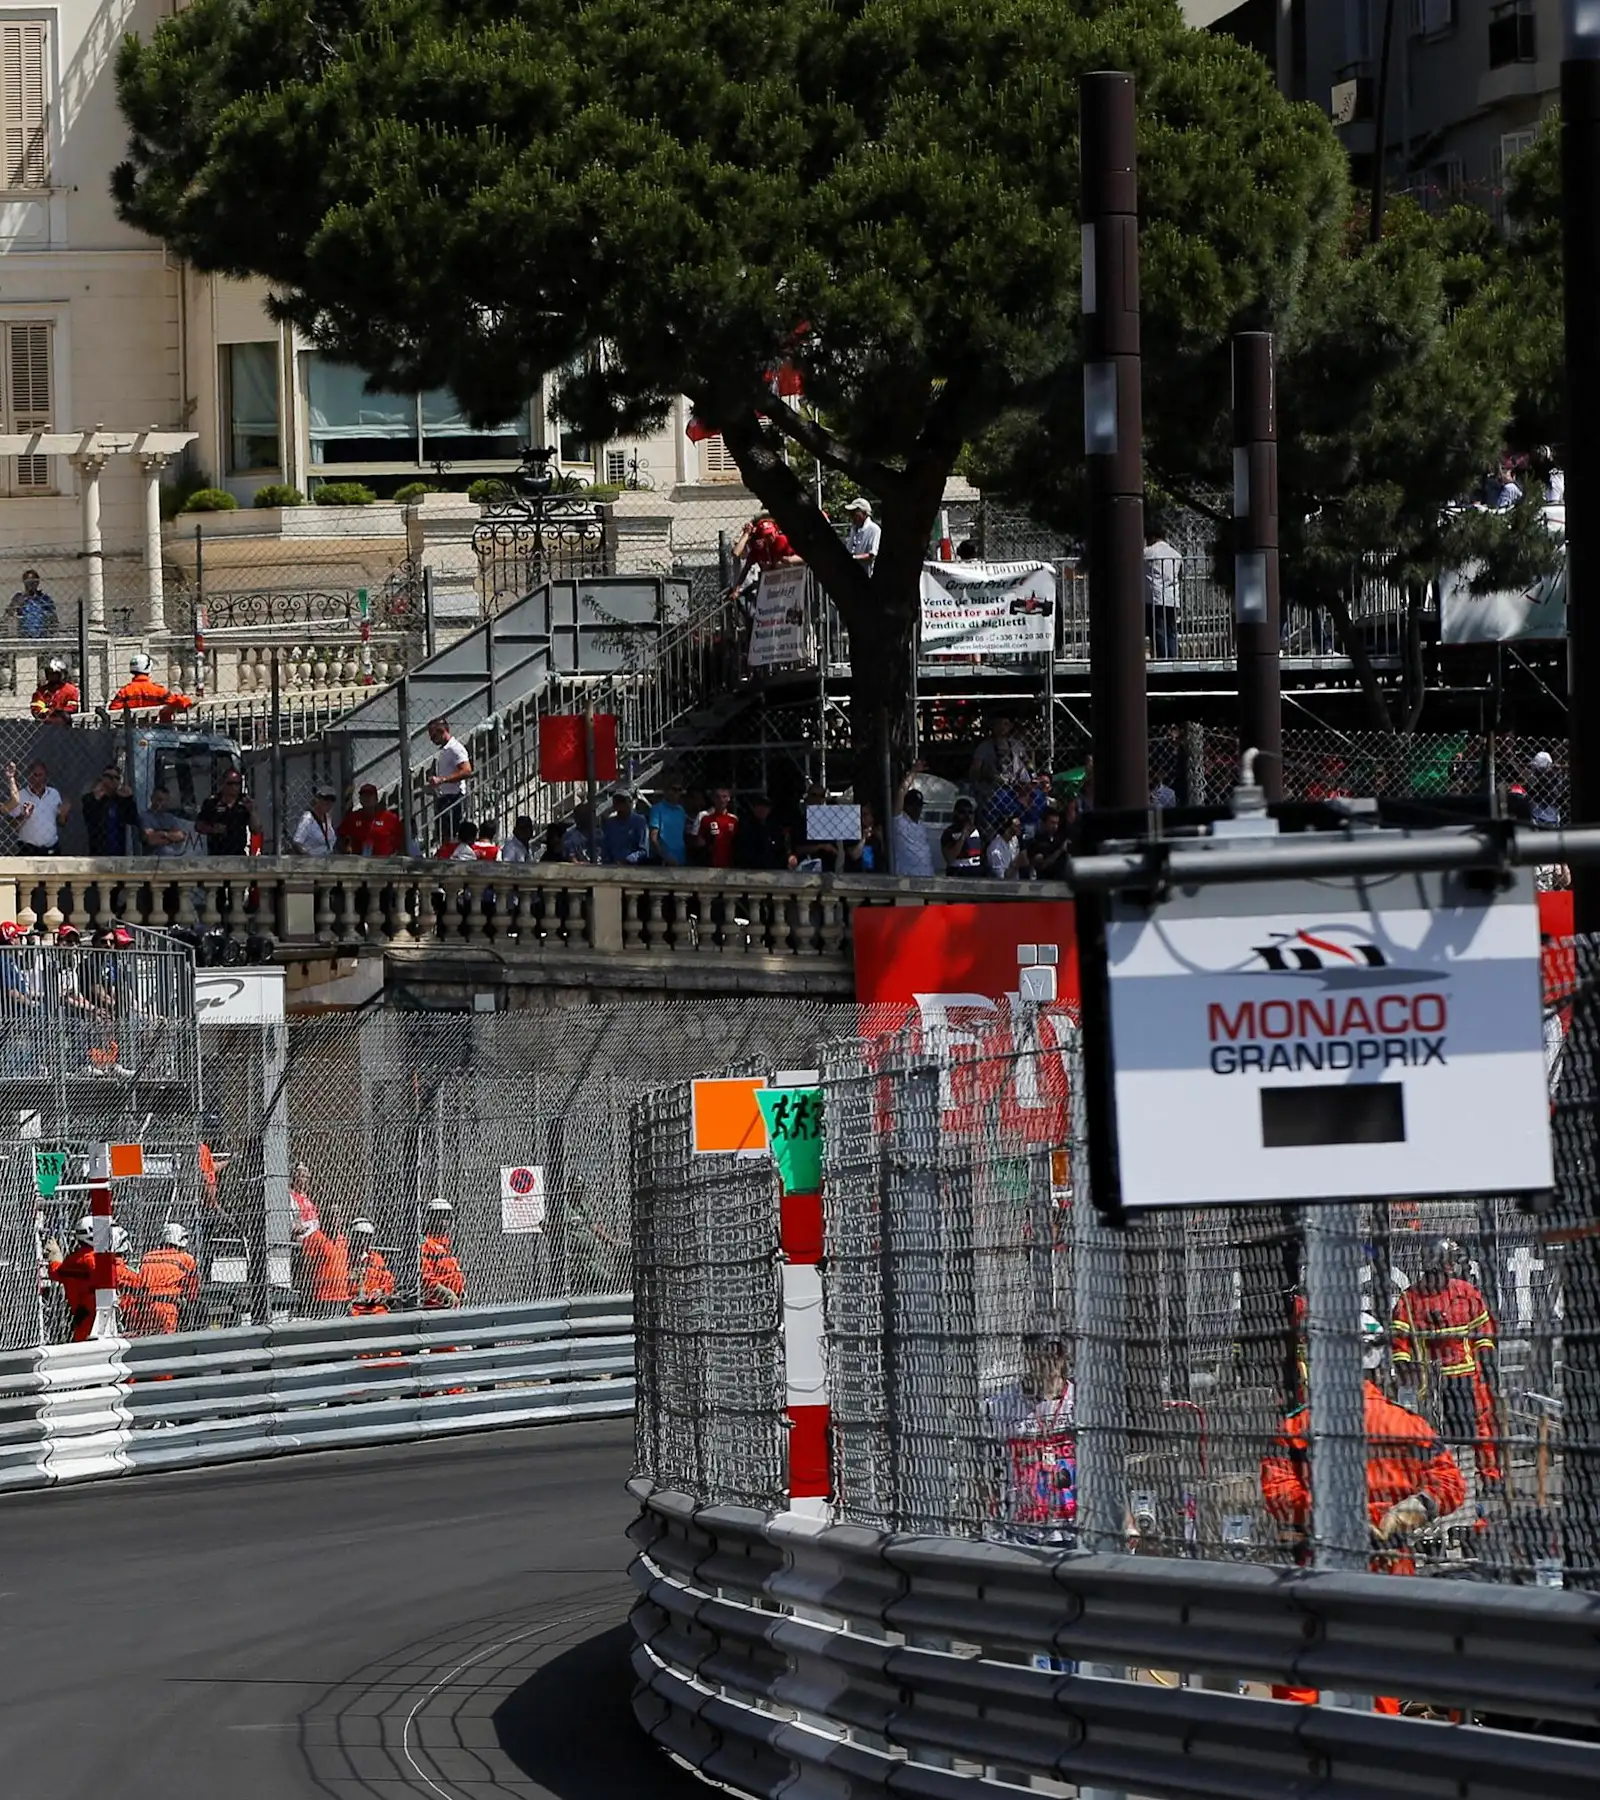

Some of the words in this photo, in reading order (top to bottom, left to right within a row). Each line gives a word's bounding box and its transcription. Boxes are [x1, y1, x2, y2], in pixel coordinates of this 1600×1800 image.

[945, 580, 983, 591] Grand
[984, 579, 1006, 589] Prix
[923, 598, 953, 607] Vente
[955, 597, 968, 607] de
[969, 595, 1005, 605] billets
[924, 610, 962, 619] Tickets
[964, 609, 981, 617] for
[985, 607, 1006, 617] sale
[924, 620, 966, 630] Vendita
[968, 619, 979, 628] di
[981, 617, 1027, 628] biglietti
[1207, 992, 1448, 1042] MONACO
